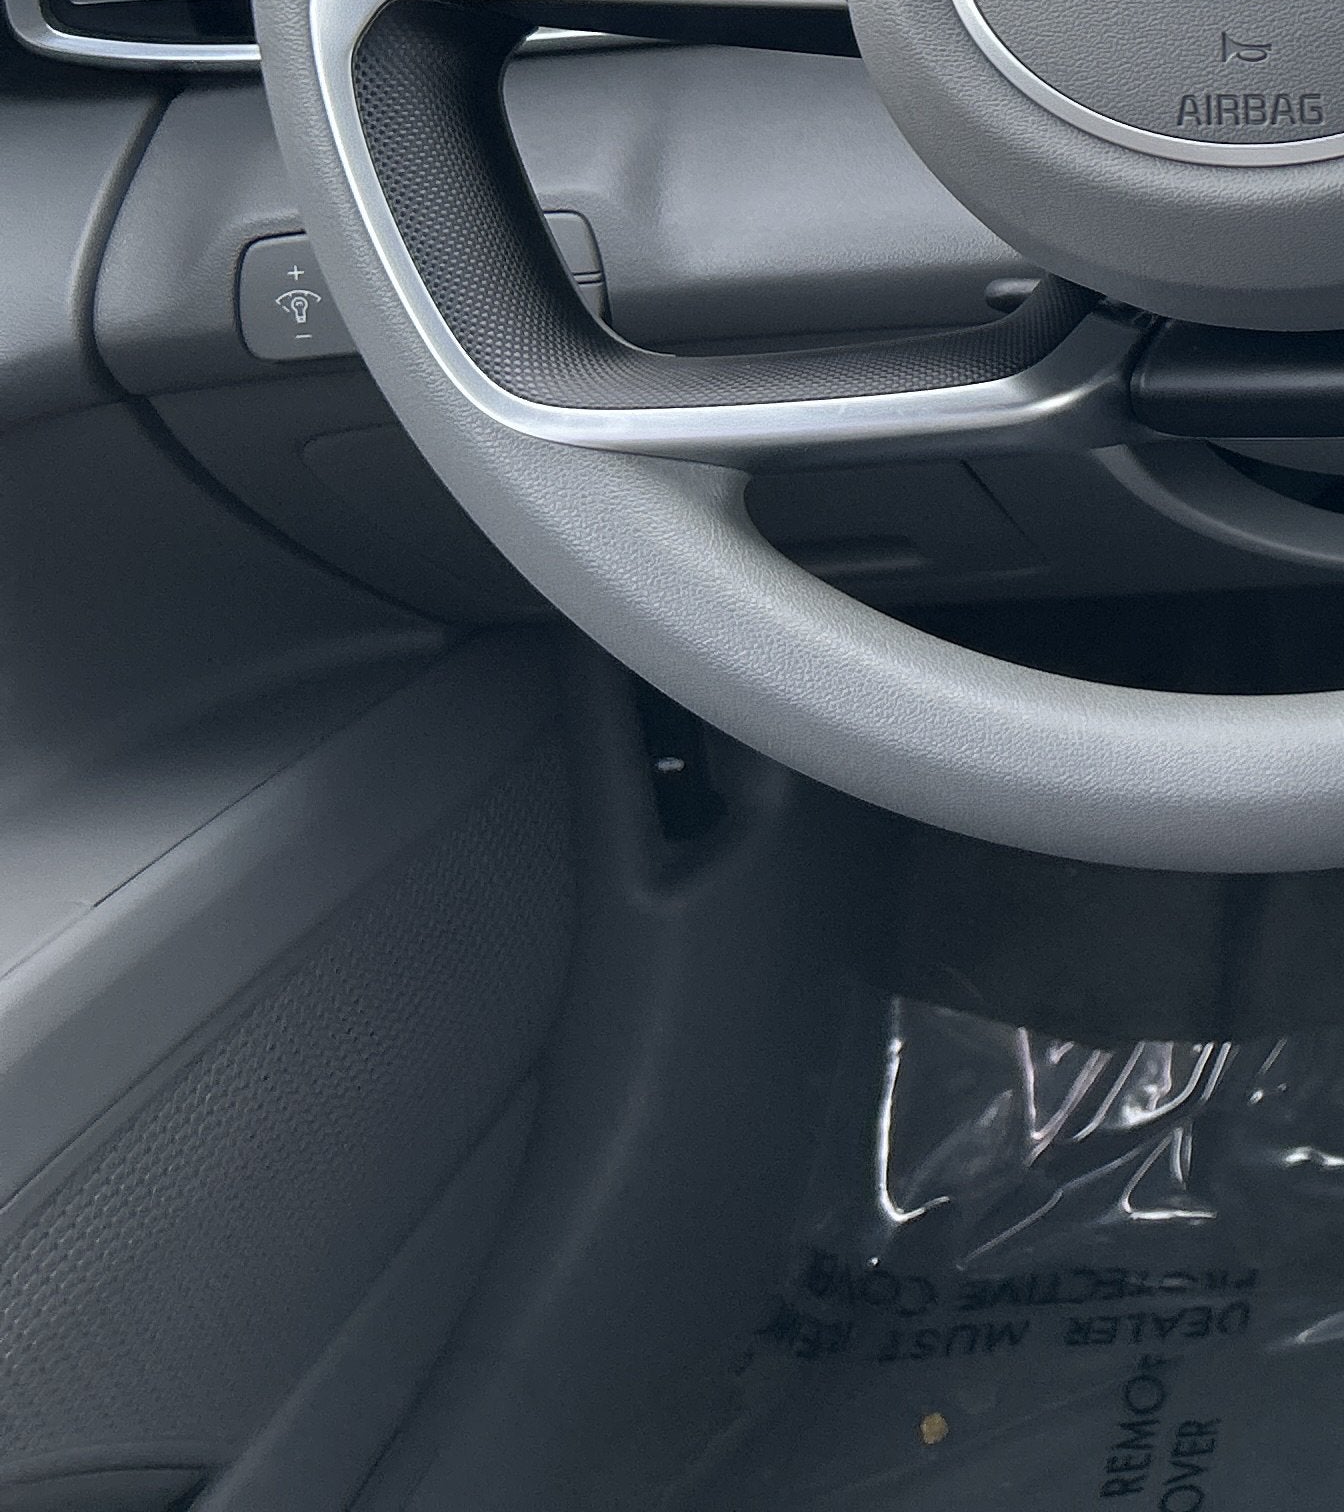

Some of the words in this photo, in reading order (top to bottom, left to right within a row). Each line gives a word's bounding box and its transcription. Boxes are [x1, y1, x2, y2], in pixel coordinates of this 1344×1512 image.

[1176, 93, 1326, 128] AIRBAG
[880, 1316, 1029, 1366] MUST
[1063, 1299, 1252, 1351] DEALER
